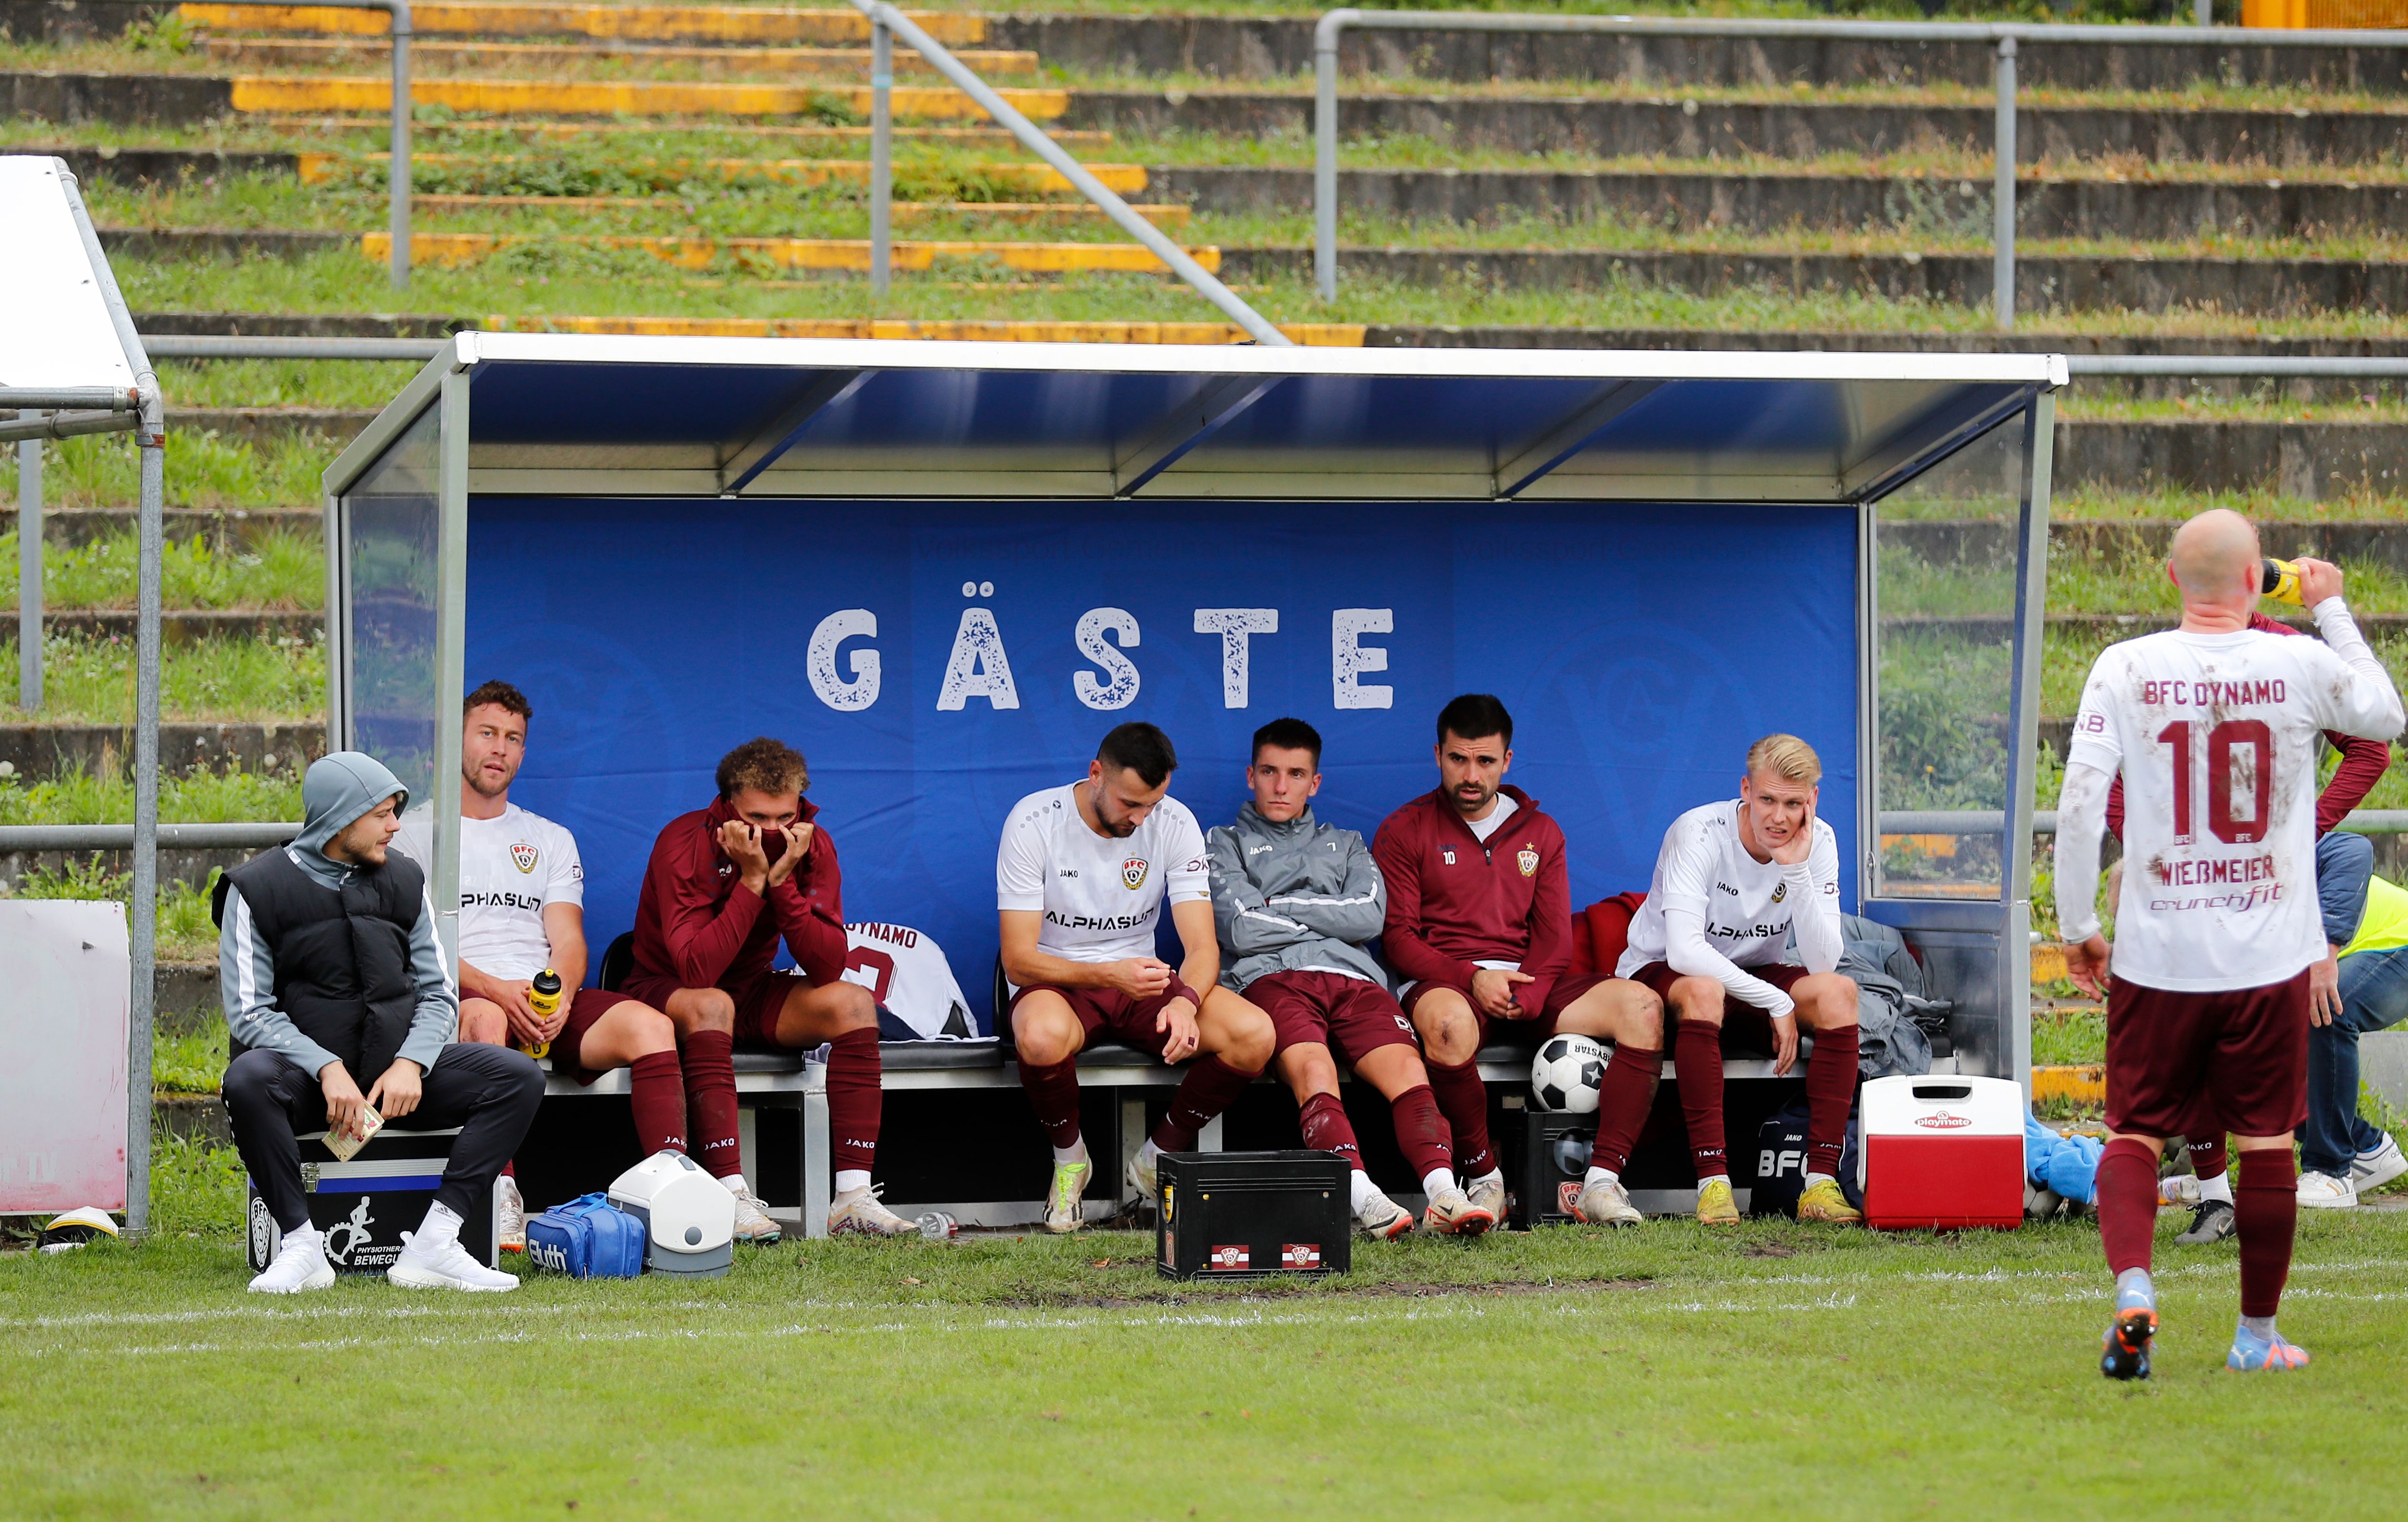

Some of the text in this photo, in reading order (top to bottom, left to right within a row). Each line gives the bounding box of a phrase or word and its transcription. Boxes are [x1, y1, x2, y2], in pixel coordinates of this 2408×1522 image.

[807, 581, 1394, 711] GÄSTE
[2144, 679, 2286, 706] BFC DYNAMO
[2157, 719, 2276, 846] 10
[2175, 834, 2189, 844] BFC
[2235, 833, 2251, 842] BFC
[513, 846, 535, 855] BFC
[1249, 845, 1273, 855] JAKO
[1326, 842, 1337, 852] 7
[1442, 851, 1456, 865] 10
[1520, 852, 1538, 861] BFC
[1124, 860, 1145, 870] BFC
[1059, 869, 1079, 878] JAKO
[1716, 881, 1738, 896] JAKO
[461, 892, 541, 912] PHASUN
[1045, 906, 1154, 930] ALPHASUN
[1916, 1116, 1970, 1127] playmate
[1784, 1133, 1803, 1142] JAKO
[705, 1137, 735, 1150] JAKO
[846, 1138, 875, 1149] JAKO
[1465, 1149, 1486, 1165] JAKO
[254, 1202, 268, 1224] BFC
[356, 1245, 405, 1254] PHYSIOTHERA
[354, 1253, 398, 1266] BEWEGU
